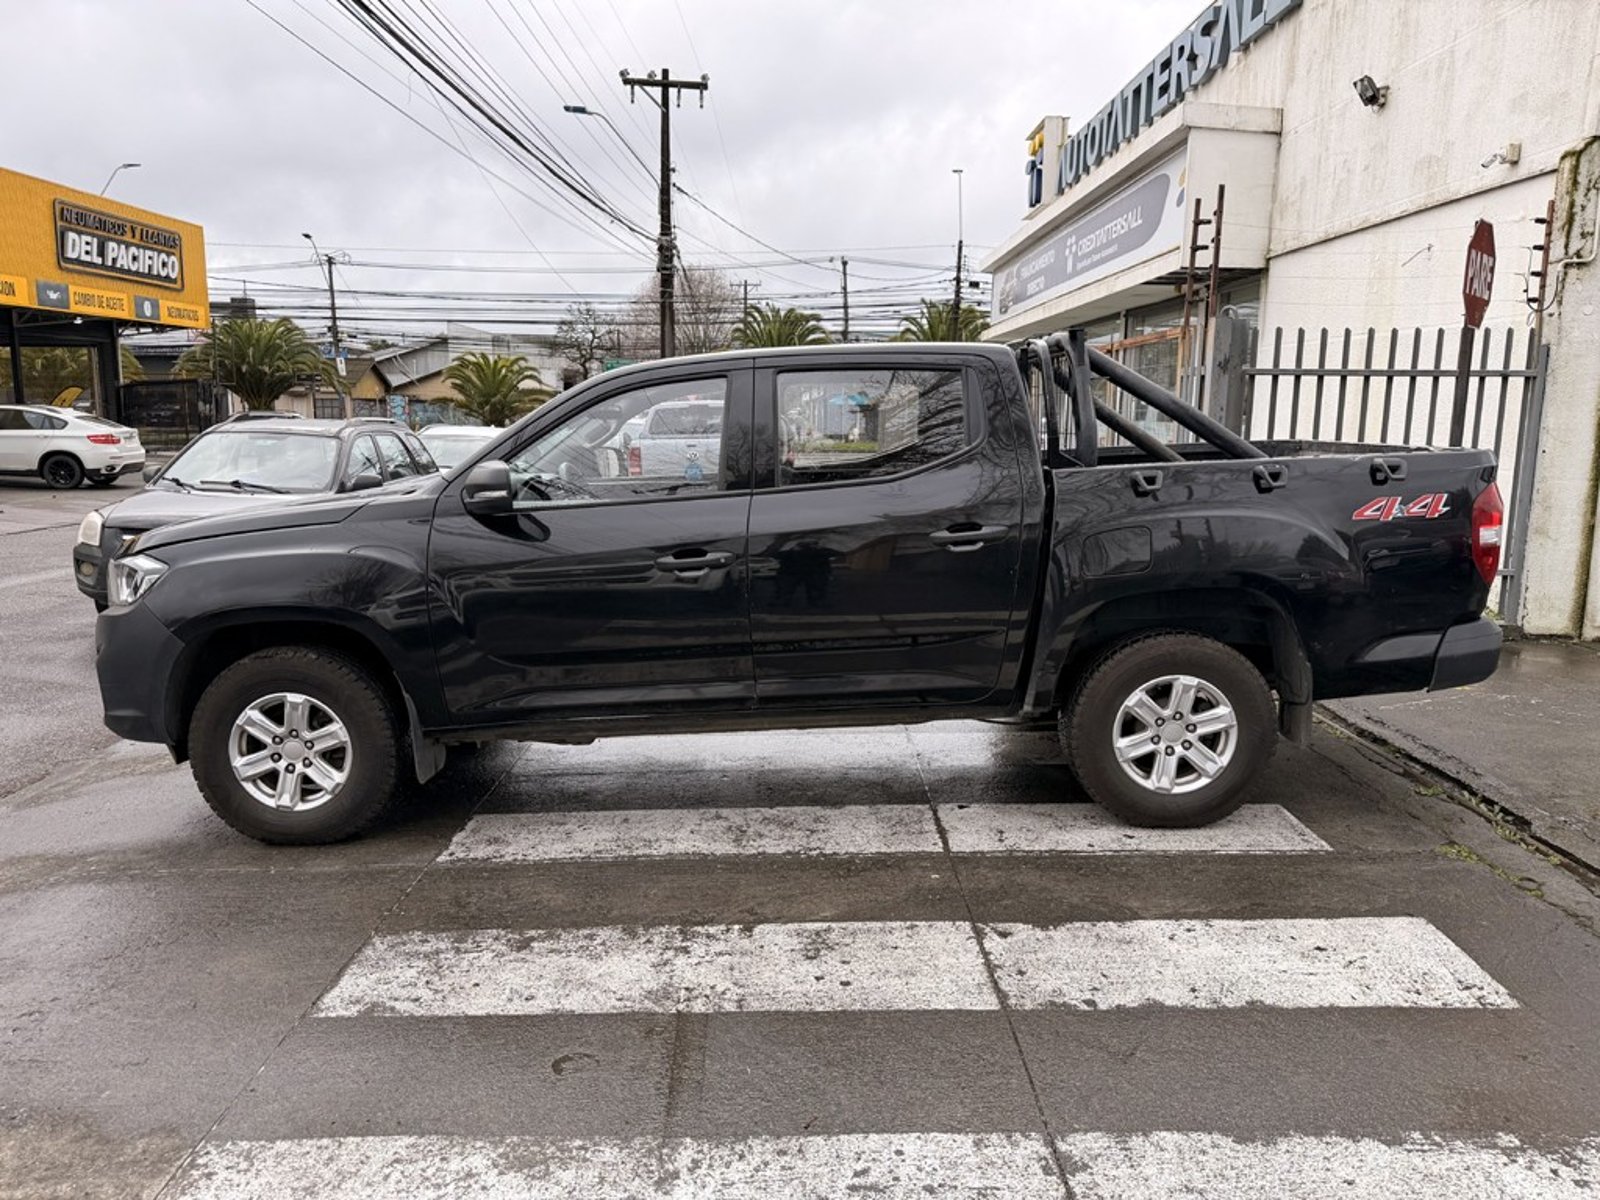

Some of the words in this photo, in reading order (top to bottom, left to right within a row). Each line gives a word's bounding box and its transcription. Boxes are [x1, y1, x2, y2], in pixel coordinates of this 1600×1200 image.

[1056, 0, 1303, 196] AUTOTATTERSAL
[61, 206, 128, 236] NEUMATICOS
[130, 224, 139, 239] Y
[140, 228, 179, 249] LLANTAS
[64, 231, 103, 265] DEL
[104, 241, 179, 279] PACIFICO
[1465, 248, 1495, 301] PARE
[0, 280, 16, 297] ION
[73, 291, 96, 308] CAMBIO
[97, 293, 105, 309] DE
[106, 296, 126, 312] ACEITE
